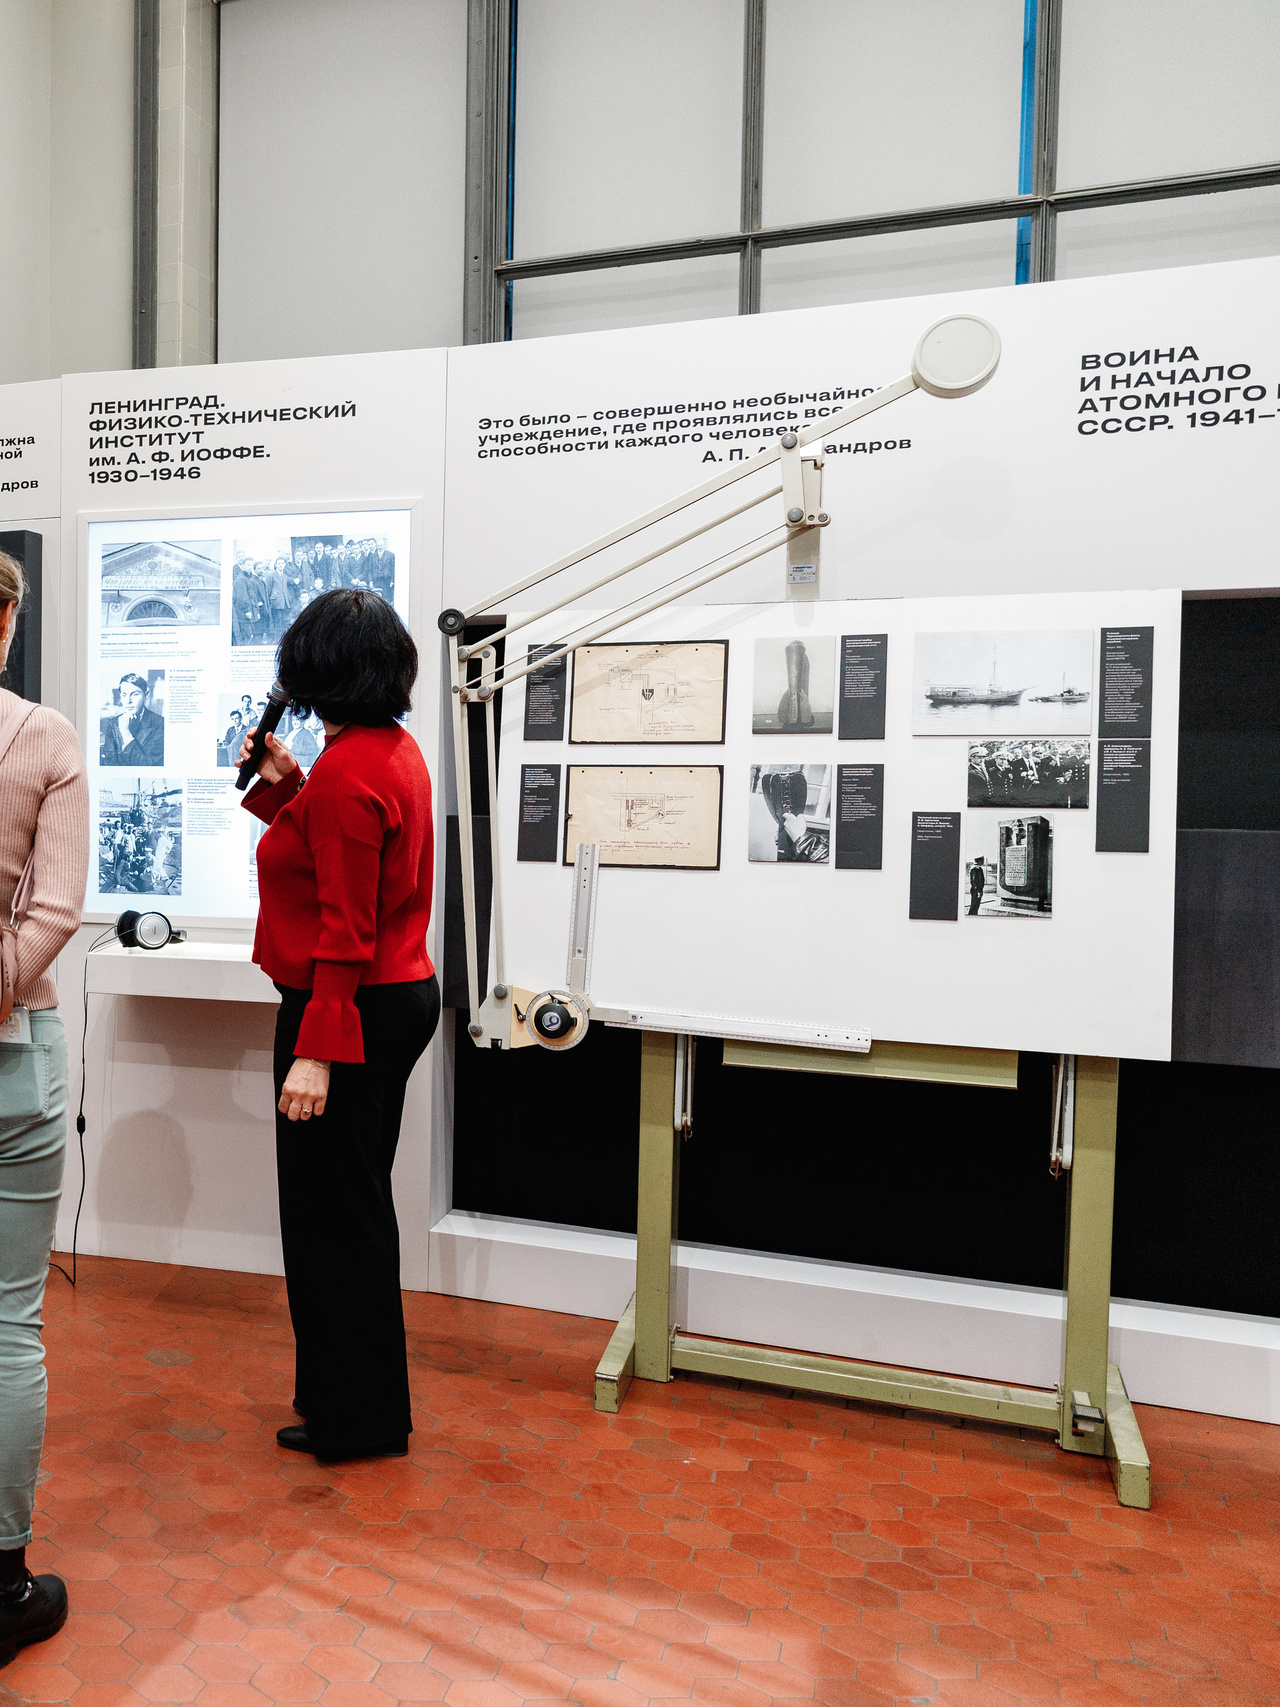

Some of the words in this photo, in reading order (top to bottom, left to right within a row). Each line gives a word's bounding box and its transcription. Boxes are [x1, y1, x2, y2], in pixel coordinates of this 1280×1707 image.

[1079, 375, 1101, 393] И
[1110, 363, 1252, 390] НАЧАЛО
[88, 394, 226, 416] ЛЕНИНГРАД.
[1077, 384, 1267, 415] АТОМНОГО
[88, 400, 357, 433] ФИЗИКО-ТЕХНИЧЕСКИЙ
[477, 425, 608, 448] учреждение,
[612, 422, 647, 436] где
[652, 410, 799, 433] проявлялись
[478, 417, 515, 430] Это
[518, 413, 571, 427] было
[592, 400, 727, 421] совершенно
[1077, 414, 1174, 436] СССР.
[1186, 407, 1280, 429] 1941–
[89, 430, 205, 450] ИНСТИТУТ
[477, 440, 609, 459] способности
[614, 432, 704, 449] каждого
[88, 455, 122, 468] им.
[125, 451, 146, 466] А.
[150, 450, 175, 464] Ф.
[180, 444, 271, 463] ИОФФЕ.
[701, 450, 723, 464] А.
[729, 447, 750, 462] П.
[88, 466, 202, 485] 1930–1946
